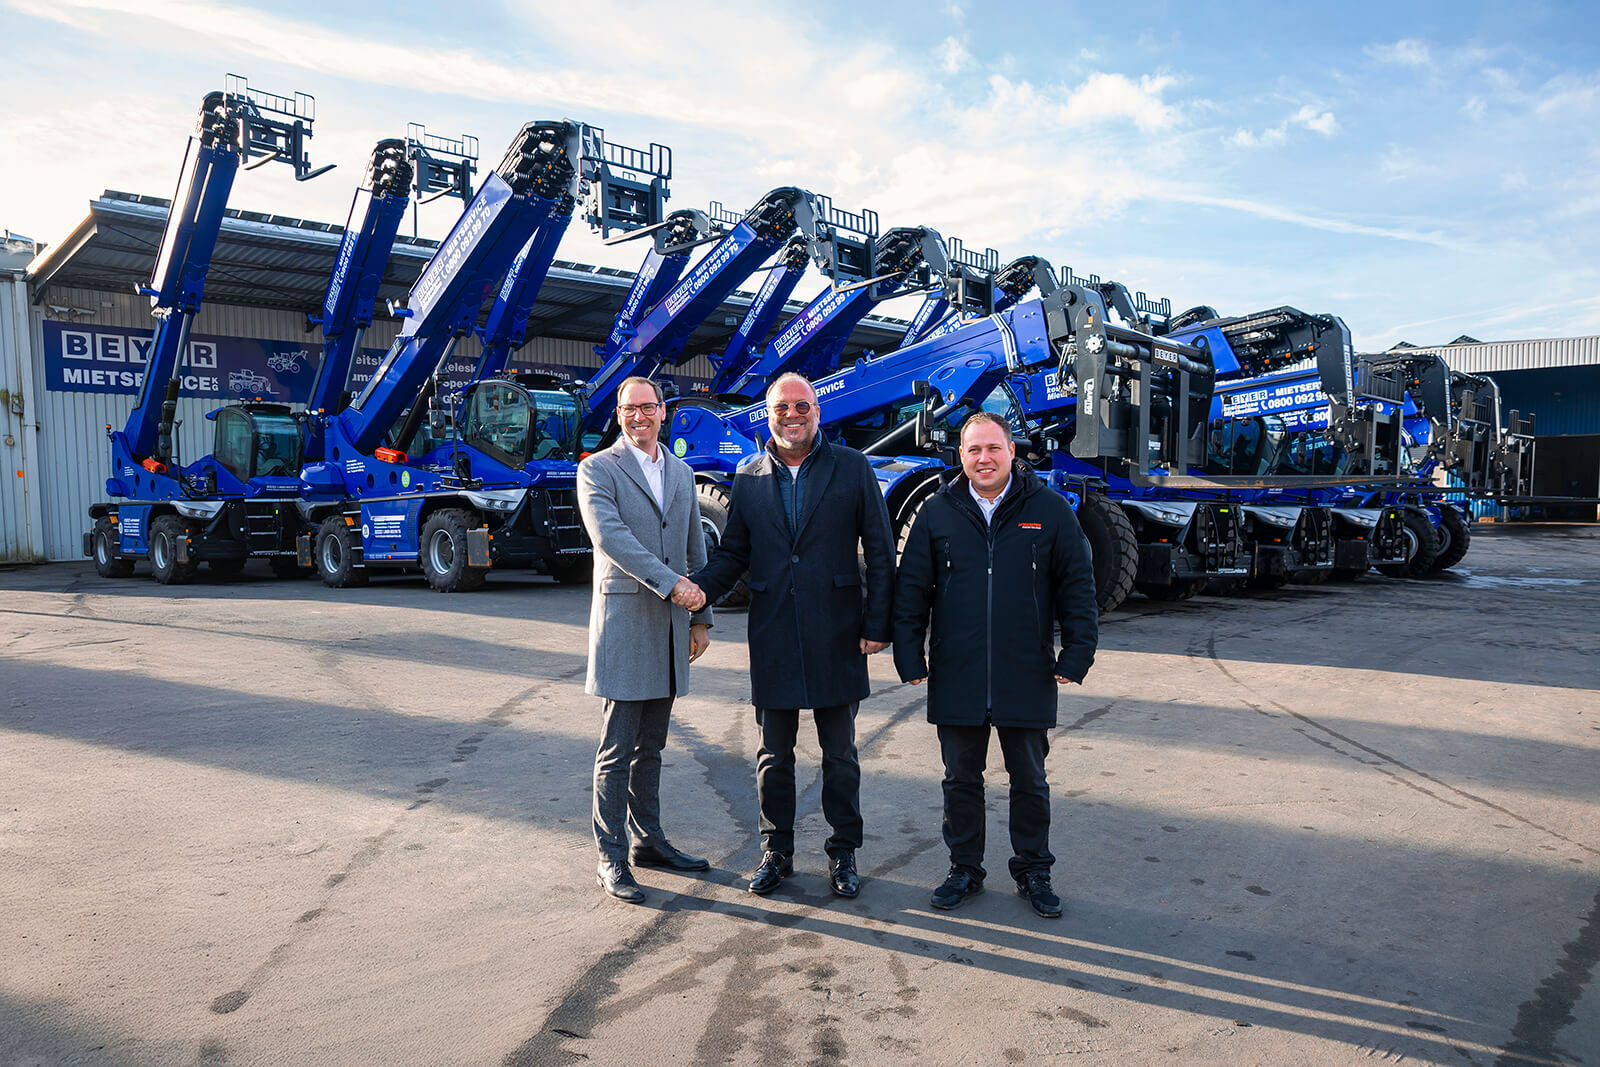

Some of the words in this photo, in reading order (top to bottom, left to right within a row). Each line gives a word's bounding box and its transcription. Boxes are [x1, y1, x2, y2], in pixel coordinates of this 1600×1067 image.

[416, 257, 445, 300] BEYER
[446, 195, 487, 257] MIETSERVICE
[445, 250, 462, 275] 0800
[460, 230, 474, 252] 092
[472, 219, 482, 233] 99
[480, 206, 490, 222] 70
[664, 278, 693, 309] BEYER
[696, 234, 736, 276] MIETSERVICE
[694, 272, 710, 290] 0800
[708, 260, 722, 275] 092
[720, 252, 730, 264] 99
[728, 243, 738, 254] 70
[806, 313, 823, 332] 0800
[822, 302, 837, 317] 092
[835, 294, 846, 306] 99
[61, 330, 218, 368] BEYR
[774, 318, 804, 350] BEYER
[1154, 348, 1178, 363] BEYER
[816, 380, 845, 398] ERVICE
[1230, 390, 1268, 404] EYER
[1276, 381, 1322, 396] MIETSER
[1268, 396, 1294, 409] 0800
[1295, 392, 1315, 406] 092
